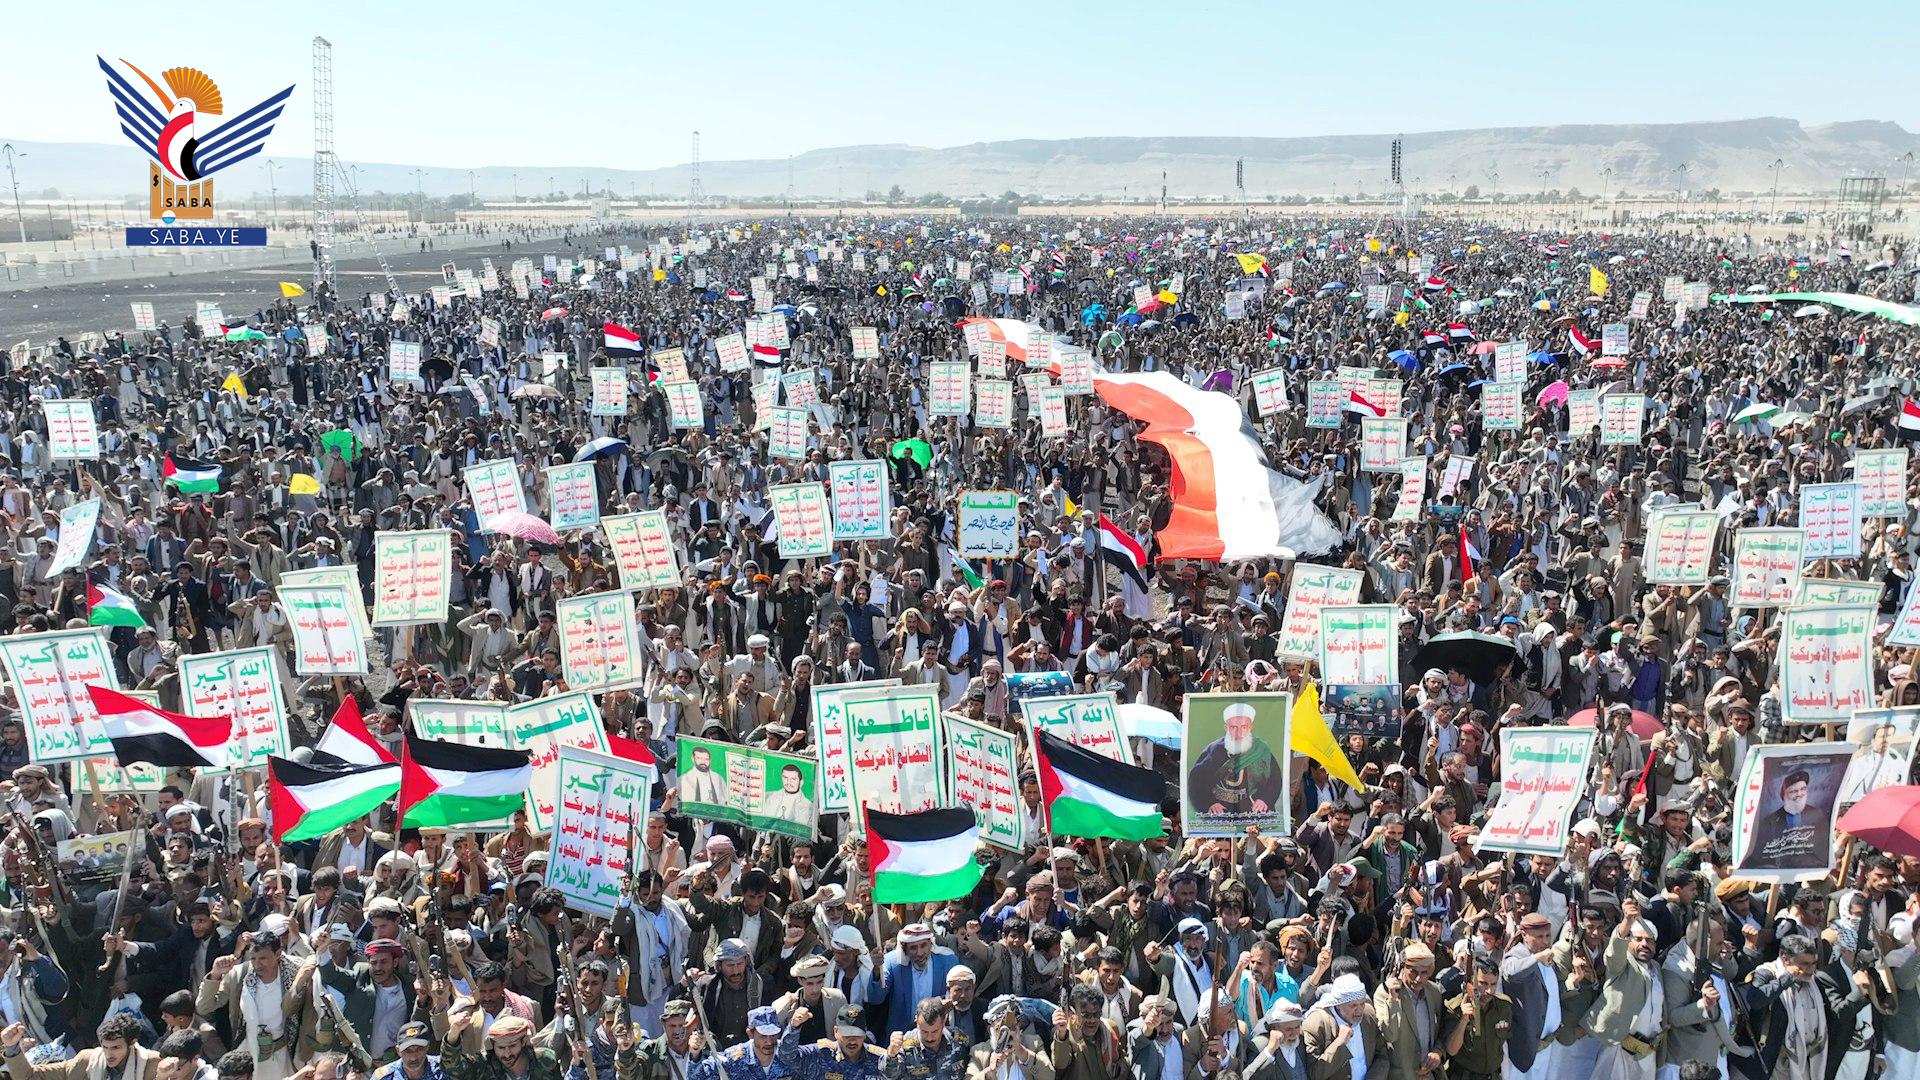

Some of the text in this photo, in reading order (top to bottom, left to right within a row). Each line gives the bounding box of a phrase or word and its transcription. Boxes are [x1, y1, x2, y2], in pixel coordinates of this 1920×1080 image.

[837, 467, 878, 482] الله أكبر
[962, 494, 1016, 508] الشهداء
[642, 518, 660, 528] الله
[862, 519, 881, 534] النصر
[383, 537, 442, 557] الله أكبر
[964, 538, 1013, 554] في كل عصر
[1741, 537, 1798, 551] قاطعوا
[417, 558, 442, 569] الموت
[416, 572, 442, 583] الموت
[1298, 573, 1355, 590] الله أكبر
[565, 601, 622, 622] الله أكبر
[1326, 615, 1386, 632] قاطعوا
[1791, 617, 1864, 640] قاطعوا
[17, 640, 97, 670] الله أكبر
[1359, 638, 1386, 654] البضائع
[1832, 645, 1861, 665] البضائع
[68, 666, 104, 682] الموت
[193, 658, 267, 688] الله أكبر
[238, 682, 270, 698] الموت
[1792, 689, 1866, 710] الإسرائيلية
[241, 701, 274, 717] الموت
[1038, 702, 1111, 731] الله أكبر
[35, 712, 65, 729] اليهود
[253, 720, 277, 734] اللعنة
[422, 713, 501, 738] قاطعوا
[512, 703, 589, 745] قاطعوا
[852, 708, 930, 742] قاطعوا
[955, 730, 1008, 759] الله أكبر
[1081, 730, 1115, 747] الموت
[248, 738, 280, 762] النصر
[855, 744, 932, 771] البضائع الأمريكية
[1510, 742, 1584, 765] قاطعوا
[986, 762, 1009, 778] الموت
[564, 769, 641, 802] الله أكبر
[987, 783, 1013, 797] الموت
[1541, 776, 1576, 795] البضائع
[564, 794, 602, 817] لأمريكا
[995, 798, 1016, 816] اللعنة
[561, 818, 599, 844] لإسرائيل
[988, 817, 1016, 837] النصر
[558, 843, 602, 867] على اليهود
[552, 864, 591, 894] للإسلام
